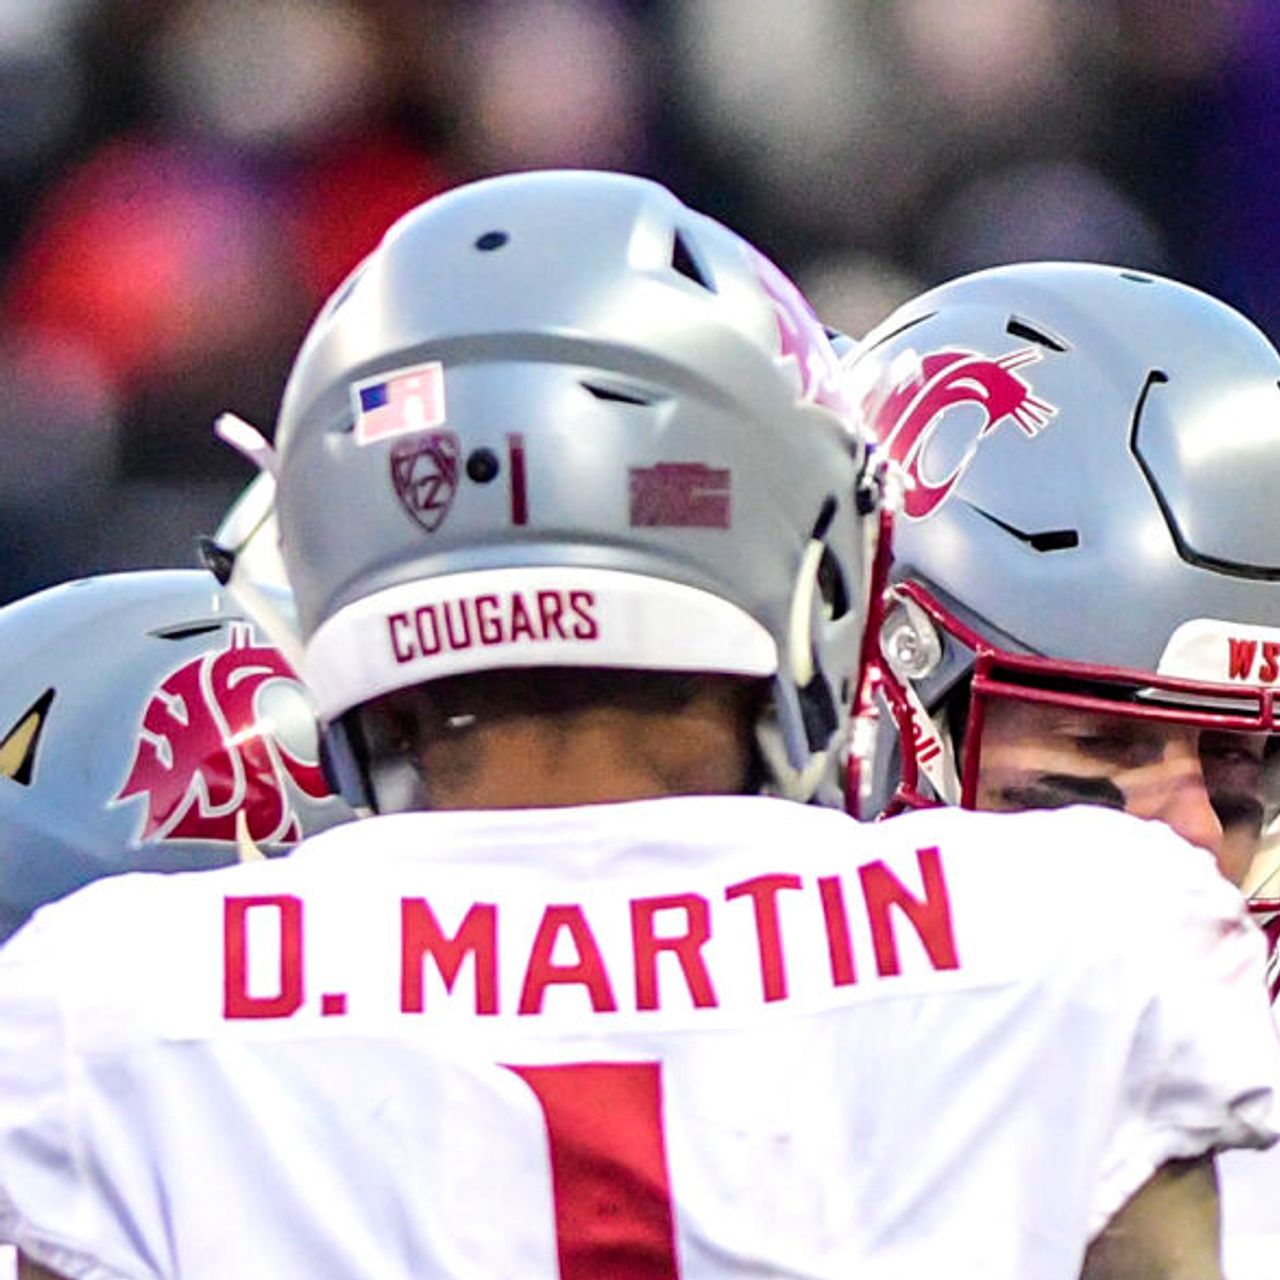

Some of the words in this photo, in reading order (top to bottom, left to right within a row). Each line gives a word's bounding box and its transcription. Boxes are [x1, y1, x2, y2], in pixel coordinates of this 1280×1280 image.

[387, 590, 601, 664] COUGARS
[222, 893, 348, 1021] D.
[399, 845, 961, 1017] MARTIN
